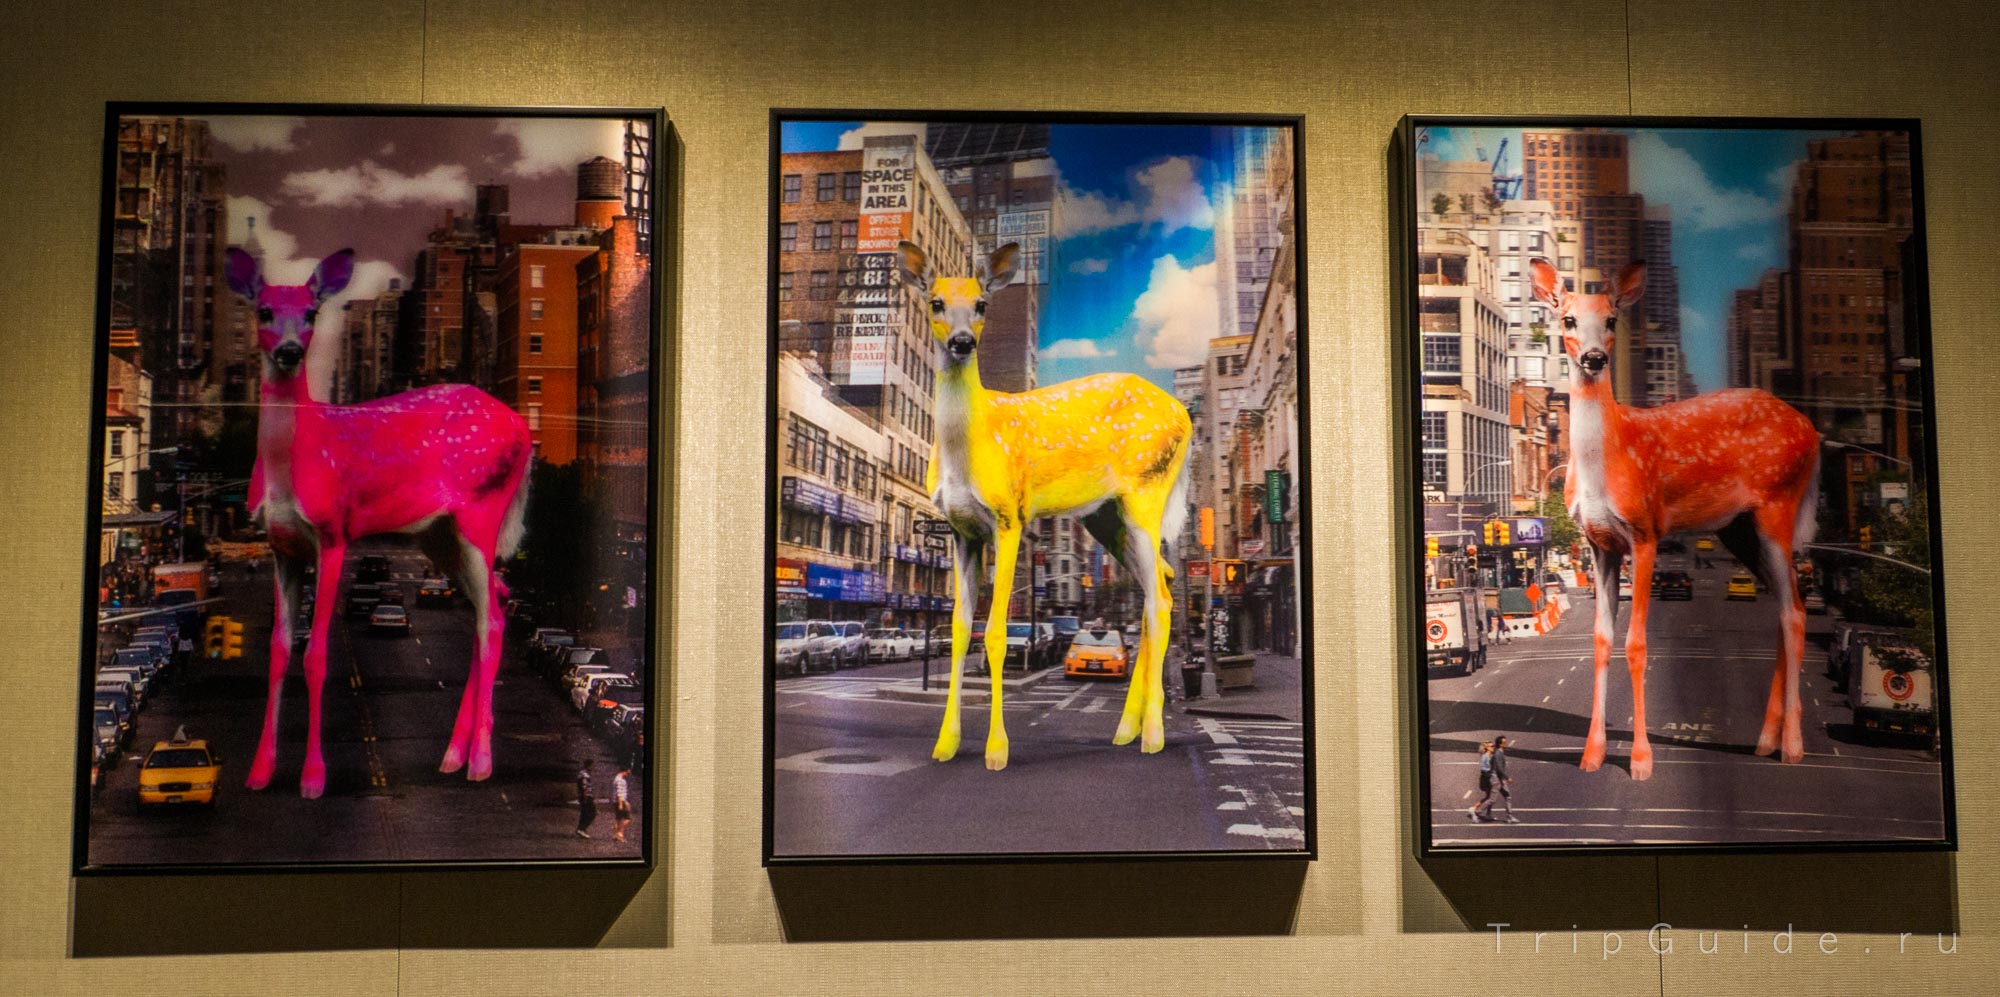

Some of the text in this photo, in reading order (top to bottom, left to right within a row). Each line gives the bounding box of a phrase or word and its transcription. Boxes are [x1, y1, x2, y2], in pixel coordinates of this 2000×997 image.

[877, 158, 900, 167] FOR
[862, 168, 913, 183] SPACE
[868, 183, 906, 193] IN THIS
[864, 195, 907, 209] AREA
[869, 215, 902, 225] OFFICES
[869, 227, 899, 237] STORES
[858, 239, 898, 249] SHOWROO
[1646, 722, 1714, 731] ANE
